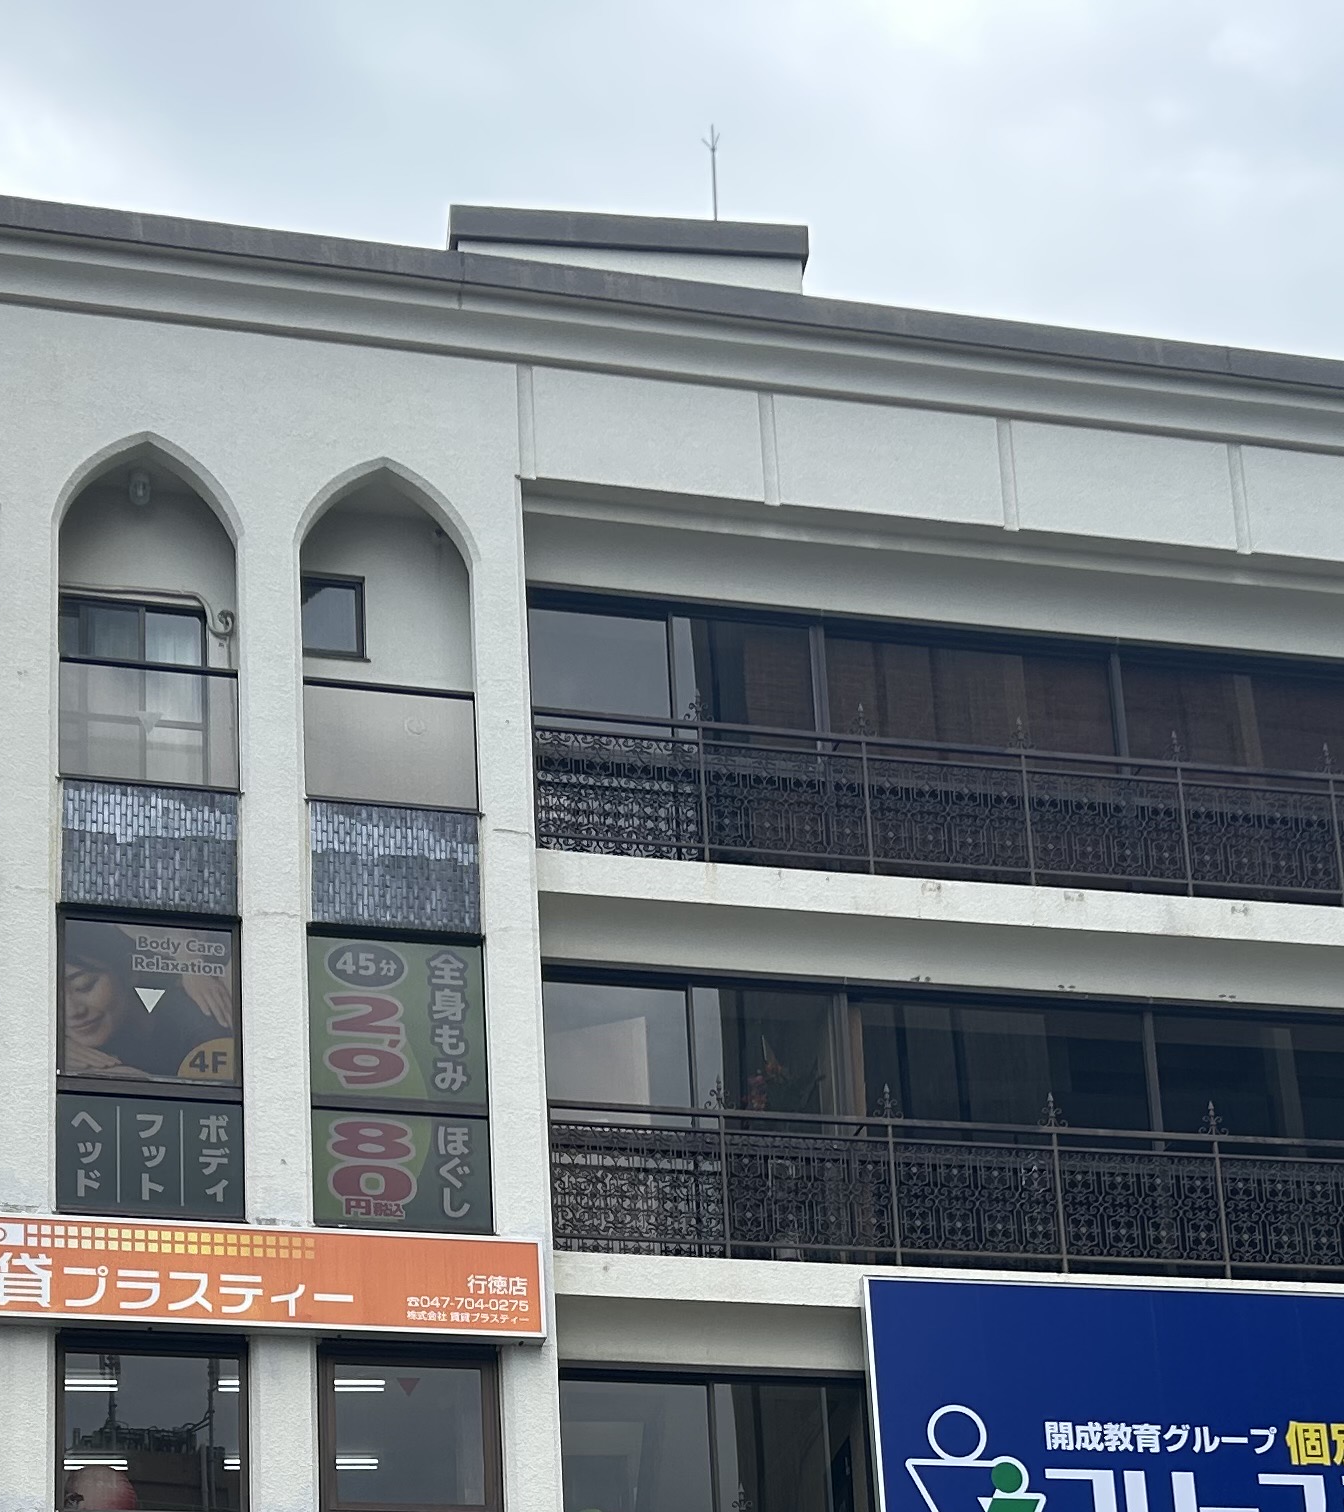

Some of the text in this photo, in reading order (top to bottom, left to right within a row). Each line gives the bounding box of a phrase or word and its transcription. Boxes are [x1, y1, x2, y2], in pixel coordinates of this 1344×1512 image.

[136, 935, 225, 956] Body Care
[132, 955, 225, 976] Relaxation
[336, 952, 397, 977] 45分
[189, 1051, 228, 1074] 4F
[71, 1111, 102, 1197] ヘッド
[136, 1113, 166, 1201] フット
[198, 1114, 230, 1203] ボディ
[467, 1274, 527, 1296] 行徳店
[420, 1296, 529, 1312] 047-704-0275
[406, 1310, 447, 1322] 株式会社
[1044, 1421, 1277, 1455] 開成教育グループ
